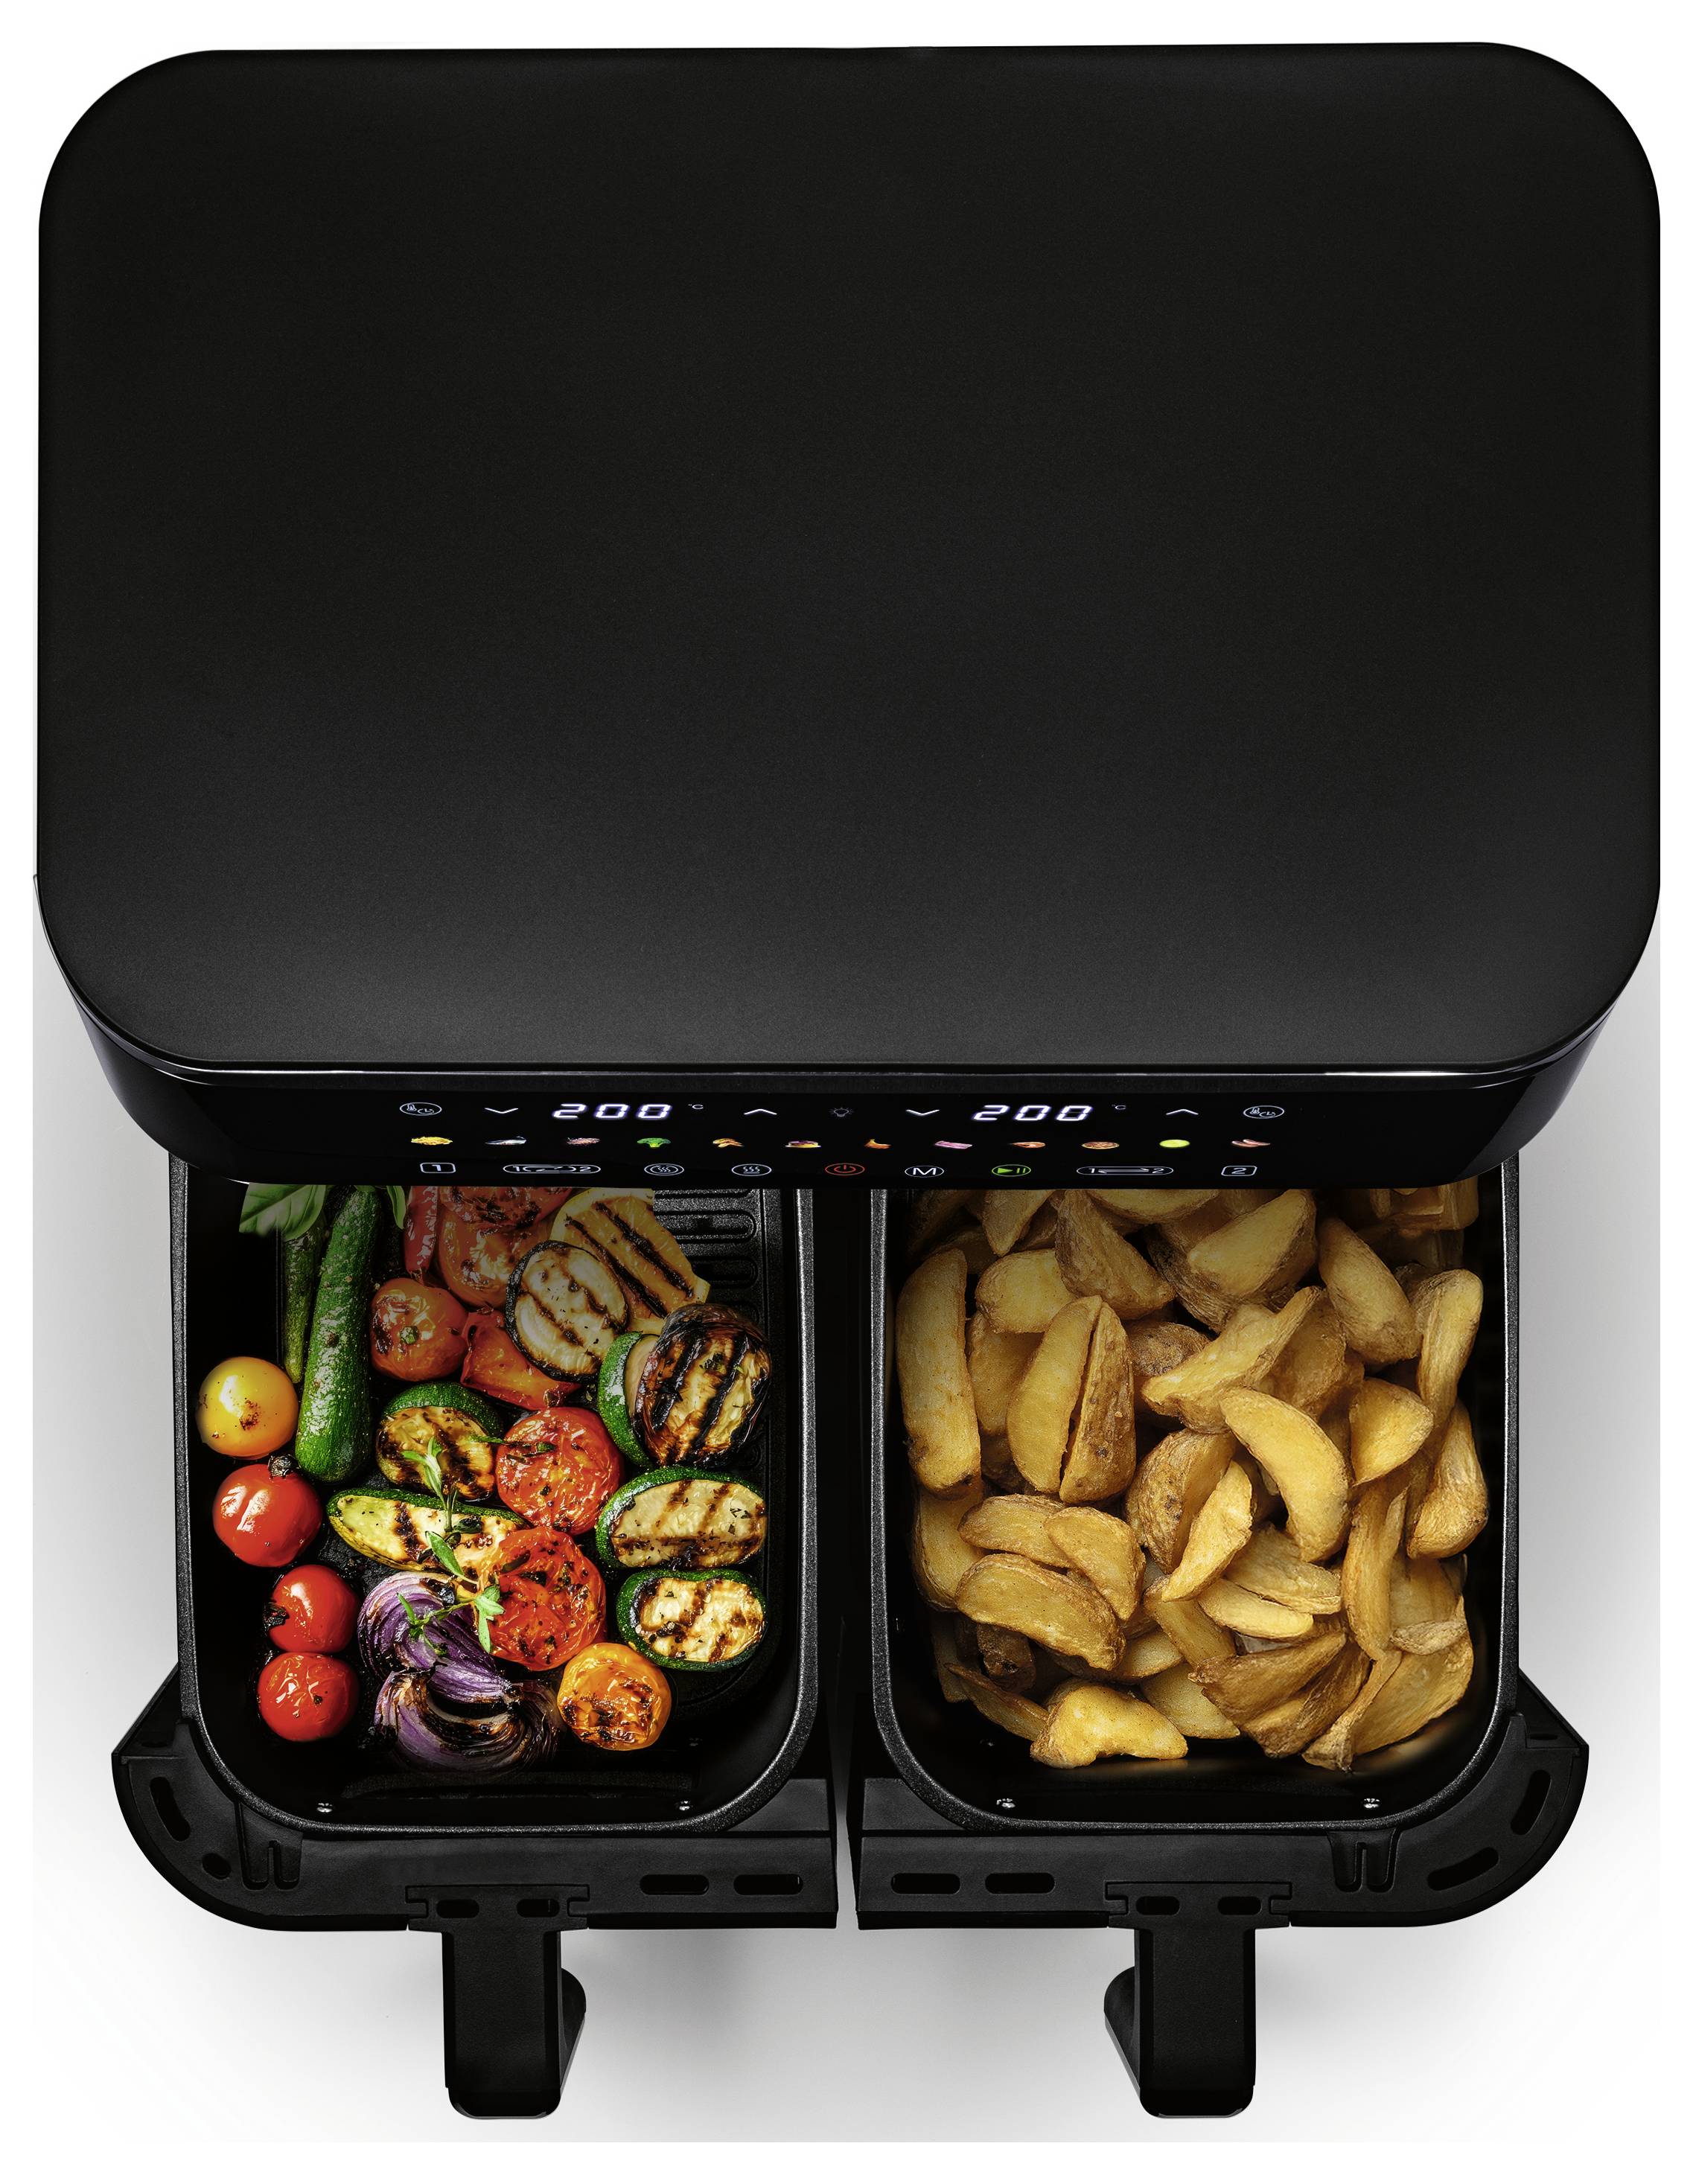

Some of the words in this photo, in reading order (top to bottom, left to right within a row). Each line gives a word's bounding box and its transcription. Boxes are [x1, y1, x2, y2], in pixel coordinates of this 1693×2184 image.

[553, 1104, 672, 1119] 200
[973, 1105, 1092, 1121] 200
[913, 1167, 937, 1175] M
